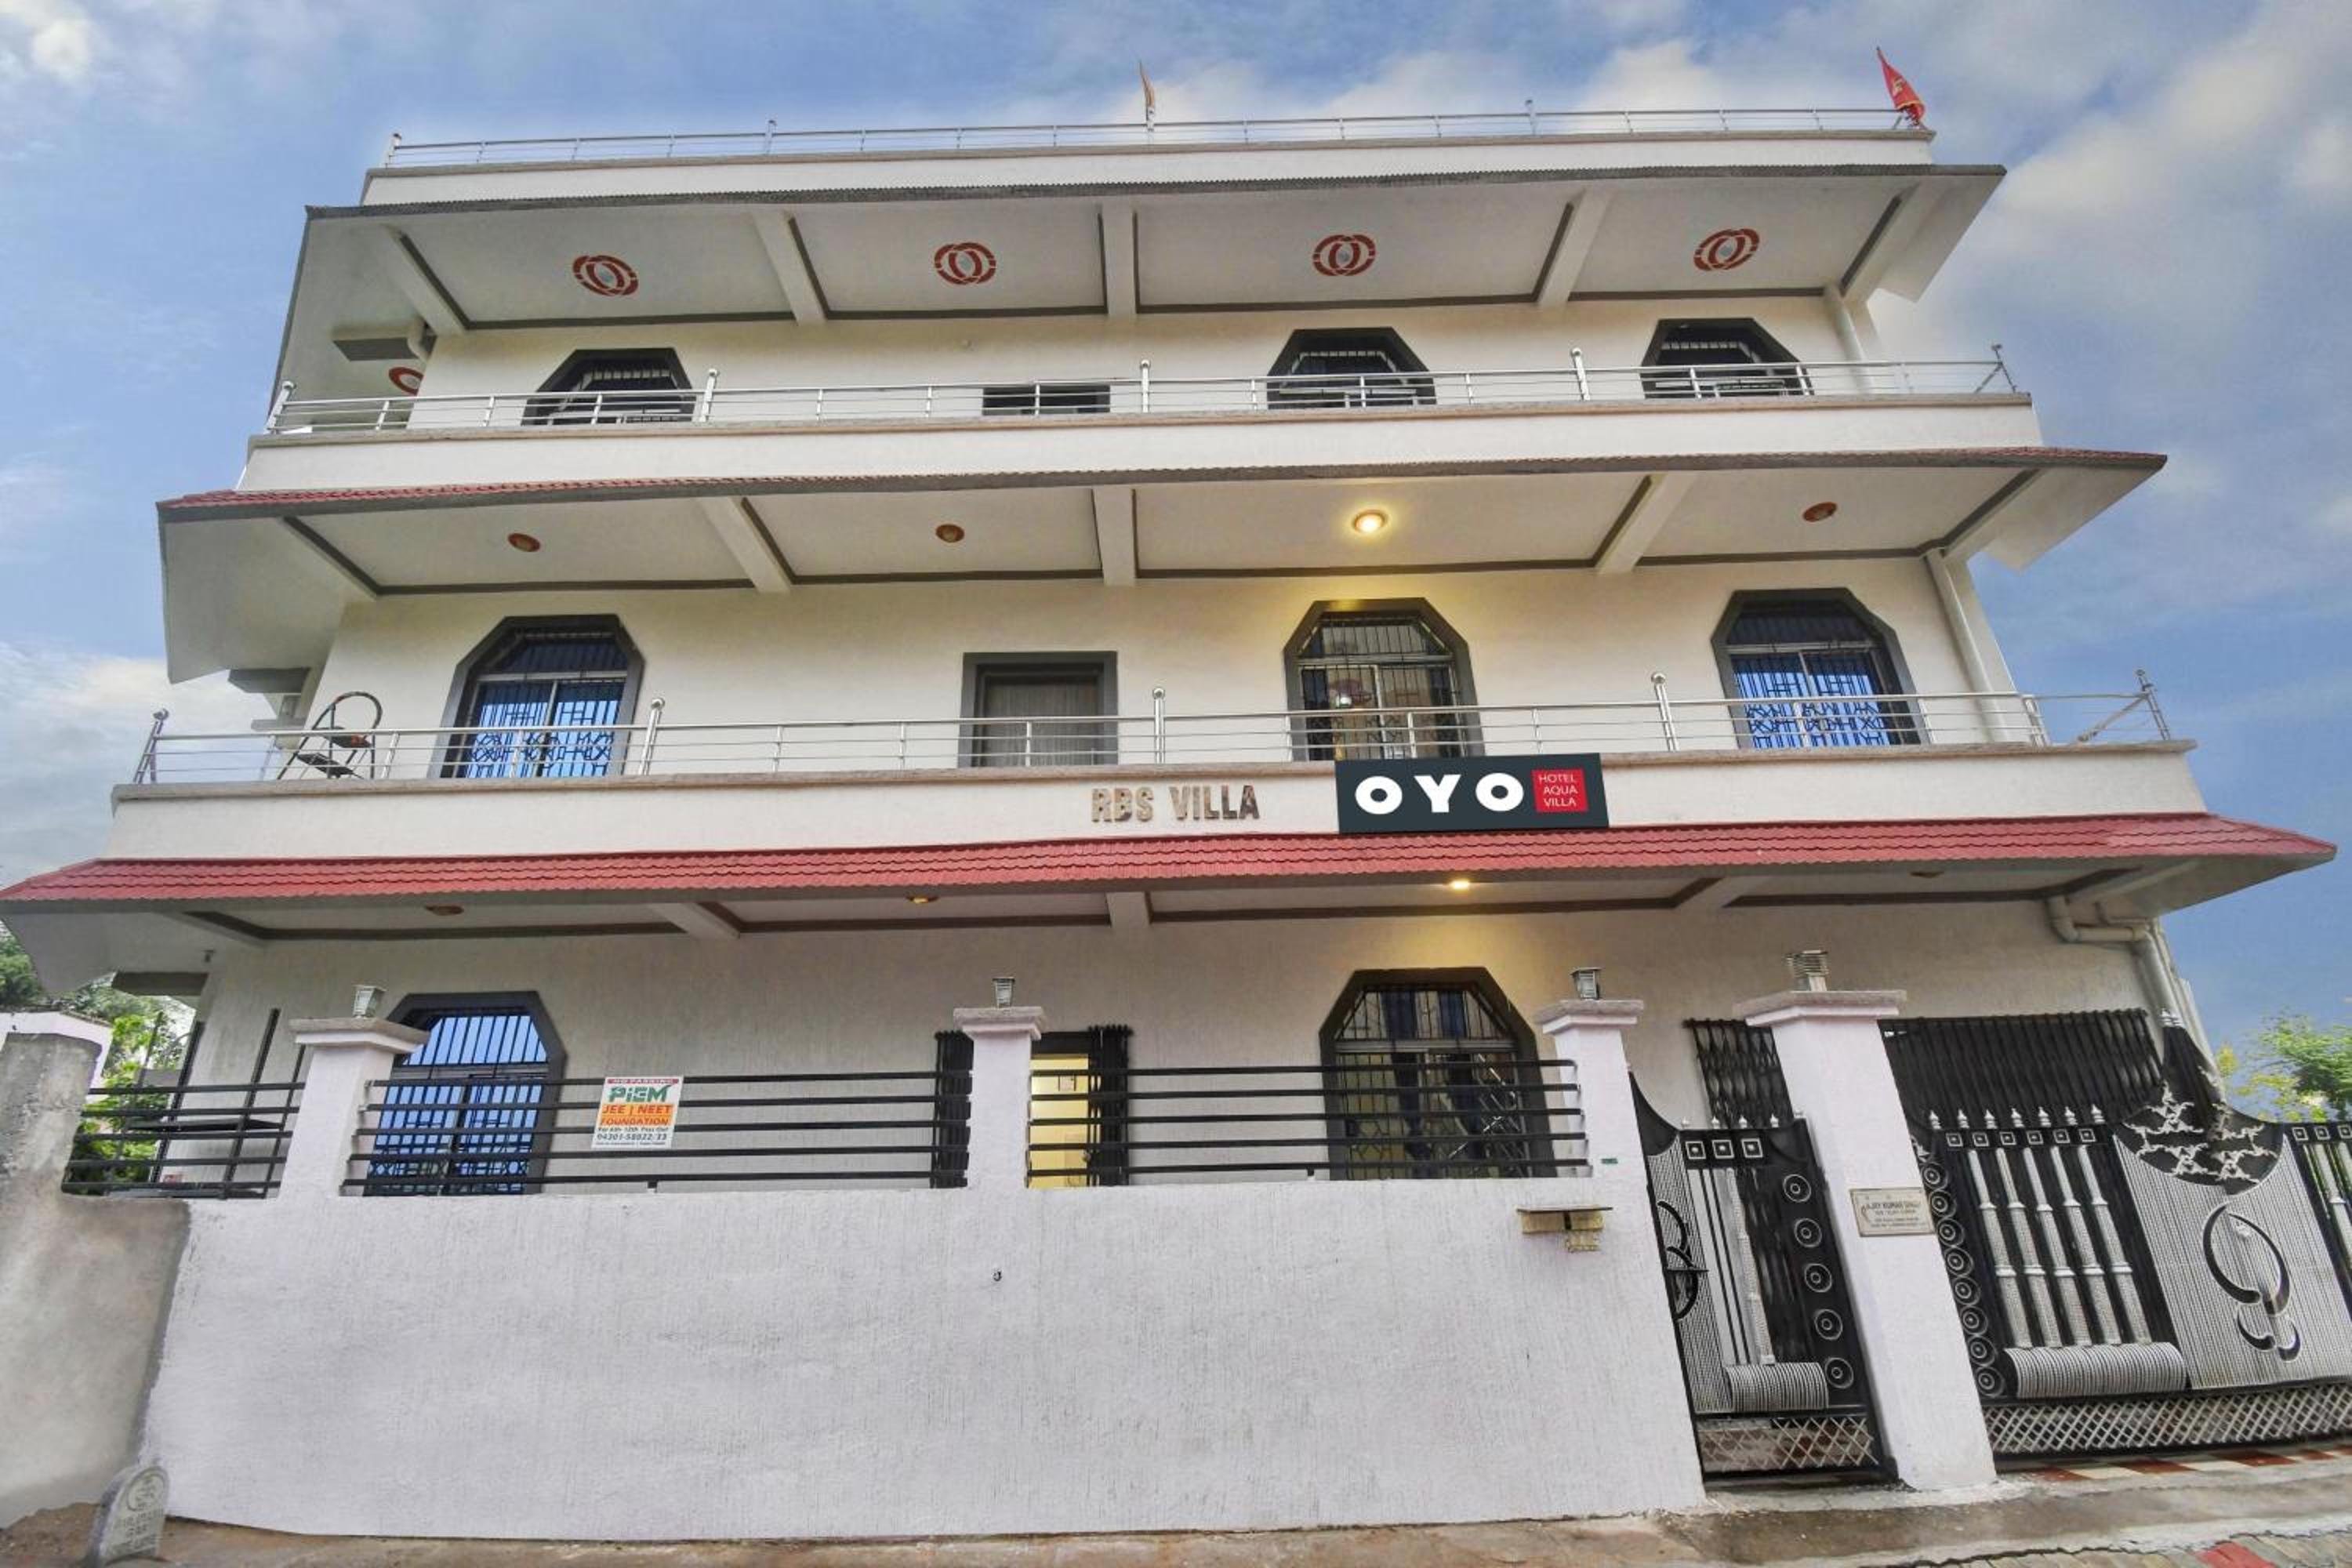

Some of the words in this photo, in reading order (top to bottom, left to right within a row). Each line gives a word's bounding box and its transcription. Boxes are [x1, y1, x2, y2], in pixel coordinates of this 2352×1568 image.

[1538, 773, 1577, 785] HOTEL
[1355, 773, 1523, 815] OYO
[1543, 785, 1578, 796] AQUA
[1091, 787, 1154, 822] RBS
[1168, 785, 1260, 820] VILLA
[1543, 797, 1577, 808] VILLA
[602, 1105, 626, 1114] JEE
[637, 1105, 673, 1114] NEET
[600, 1117, 670, 1127] FOUNDATION
